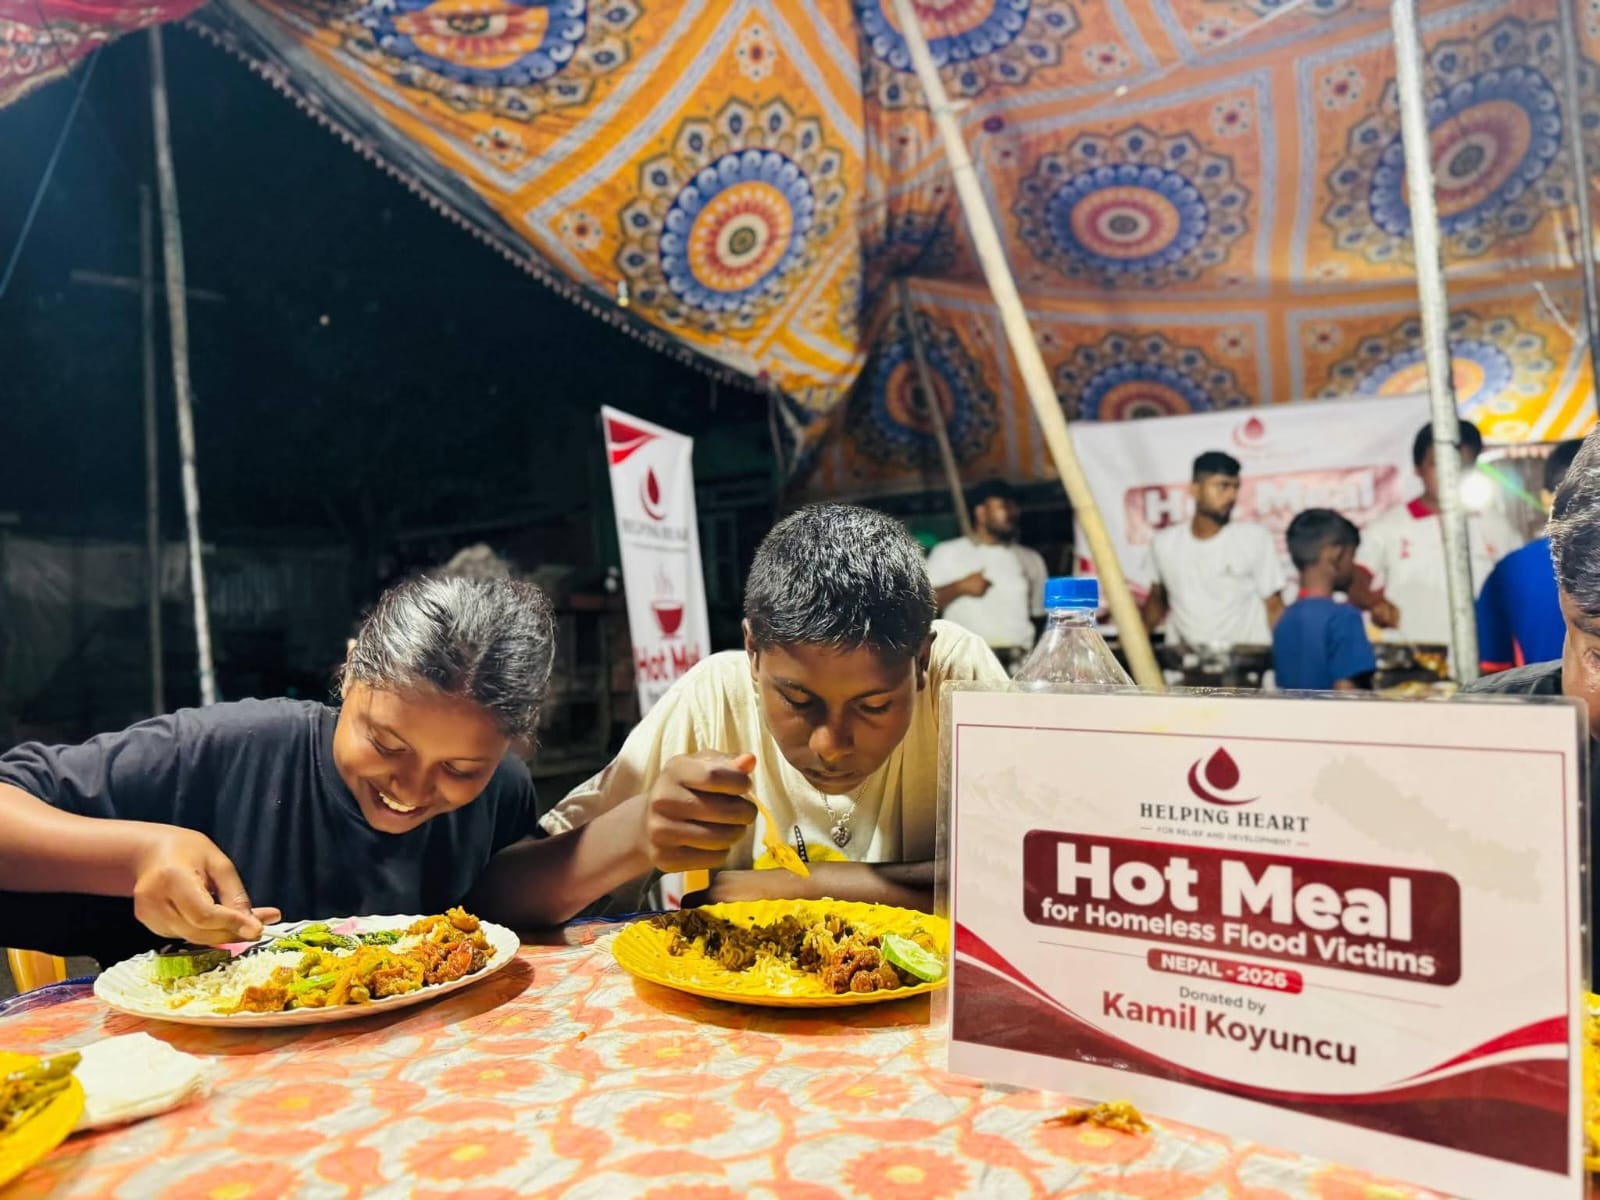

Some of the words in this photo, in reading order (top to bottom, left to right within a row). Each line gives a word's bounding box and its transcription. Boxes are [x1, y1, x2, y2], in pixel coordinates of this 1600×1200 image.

[1140, 803, 1229, 825] HELPING
[1238, 812, 1310, 832] HEART
[1177, 828, 1203, 837] RELIEF
[1206, 832, 1225, 840] AND
[1227, 833, 1292, 846] DEVELOPMENT
[1056, 842, 1199, 911] Hot
[1221, 860, 1412, 941] Meal
[1041, 898, 1078, 922] for
[1086, 905, 1216, 942] Homeless
[1223, 922, 1307, 956] Flood
[1313, 935, 1436, 977] Victims
[1161, 953, 1223, 978] NEPAL
[1237, 965, 1289, 989] 2026
[1179, 986, 1244, 1009] Donated
[1247, 996, 1266, 1015] by
[1102, 991, 1196, 1033] Kamil
[1206, 1010, 1357, 1066] Koyuncu
